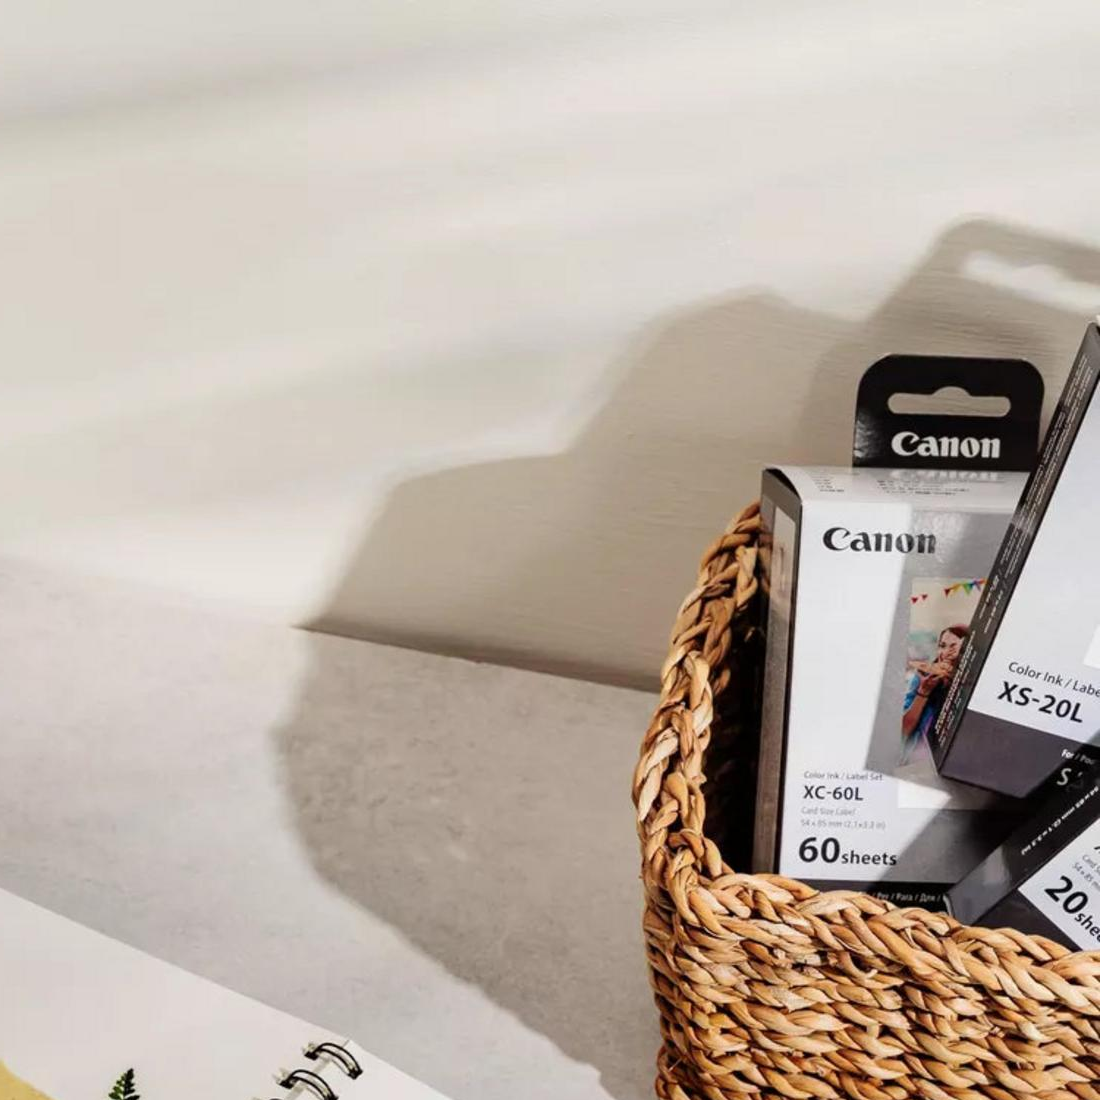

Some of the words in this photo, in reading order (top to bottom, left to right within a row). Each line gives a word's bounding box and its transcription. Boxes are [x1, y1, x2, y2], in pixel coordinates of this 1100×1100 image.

[891, 431, 1001, 459] Canon
[822, 526, 937, 554] Canon
[1008, 661, 1042, 680] Color
[1043, 672, 1064, 686] Ink
[997, 680, 1083, 723] XS-20L
[803, 770, 825, 780] Color
[827, 771, 839, 780] Ink
[846, 772, 869, 781] Label
[869, 772, 883, 781] Set
[802, 785, 864, 801] XC-60L
[798, 836, 841, 864] 60
[841, 849, 898, 867] sheets
[1044, 875, 1089, 914] 20
